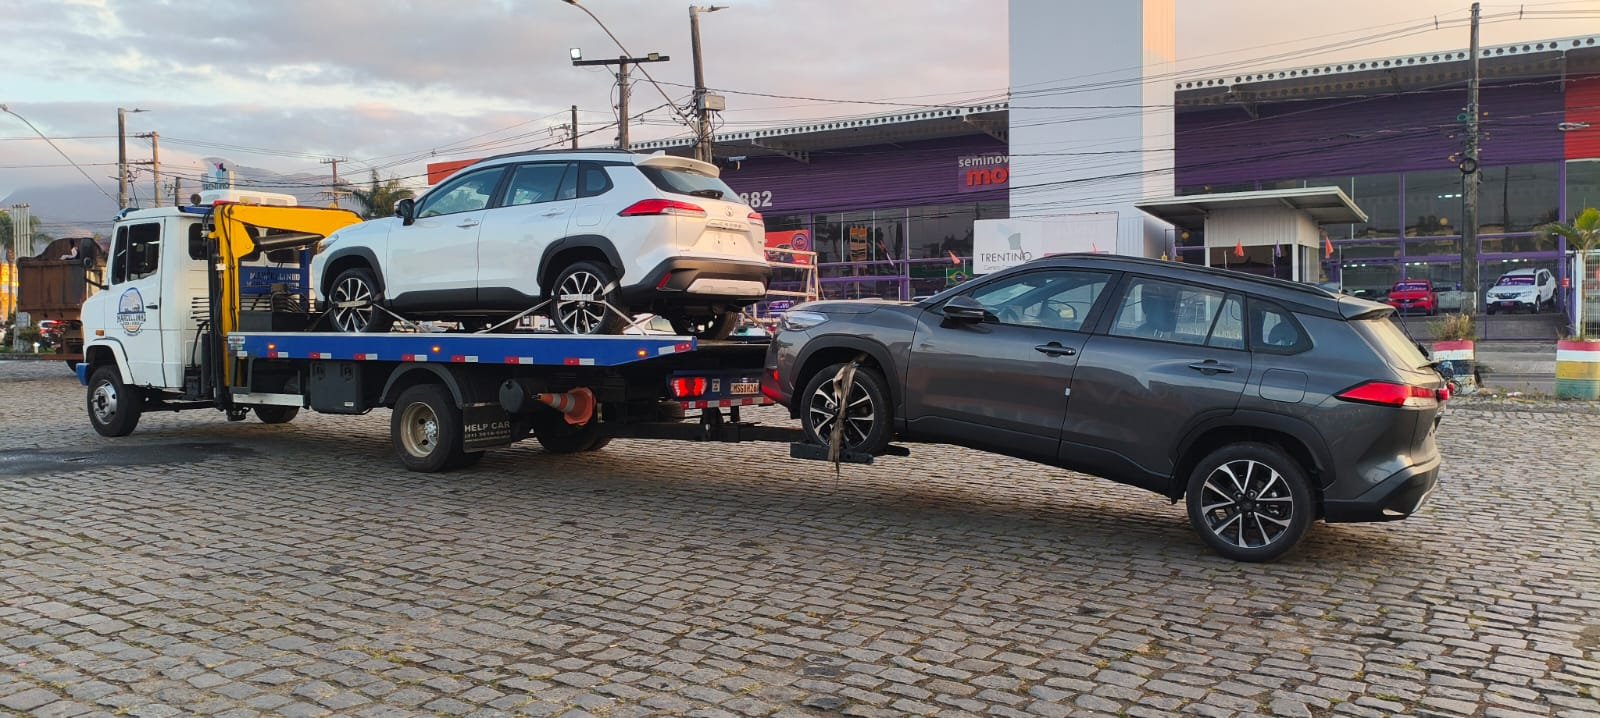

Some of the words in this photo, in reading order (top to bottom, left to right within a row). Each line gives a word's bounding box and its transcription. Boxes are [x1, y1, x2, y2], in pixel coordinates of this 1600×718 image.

[958, 155, 1009, 168] seminov
[966, 167, 1009, 187] mo
[980, 251, 1033, 264] TRENTINO
[464, 423, 489, 433] HELP
[491, 420, 510, 430] CAR
